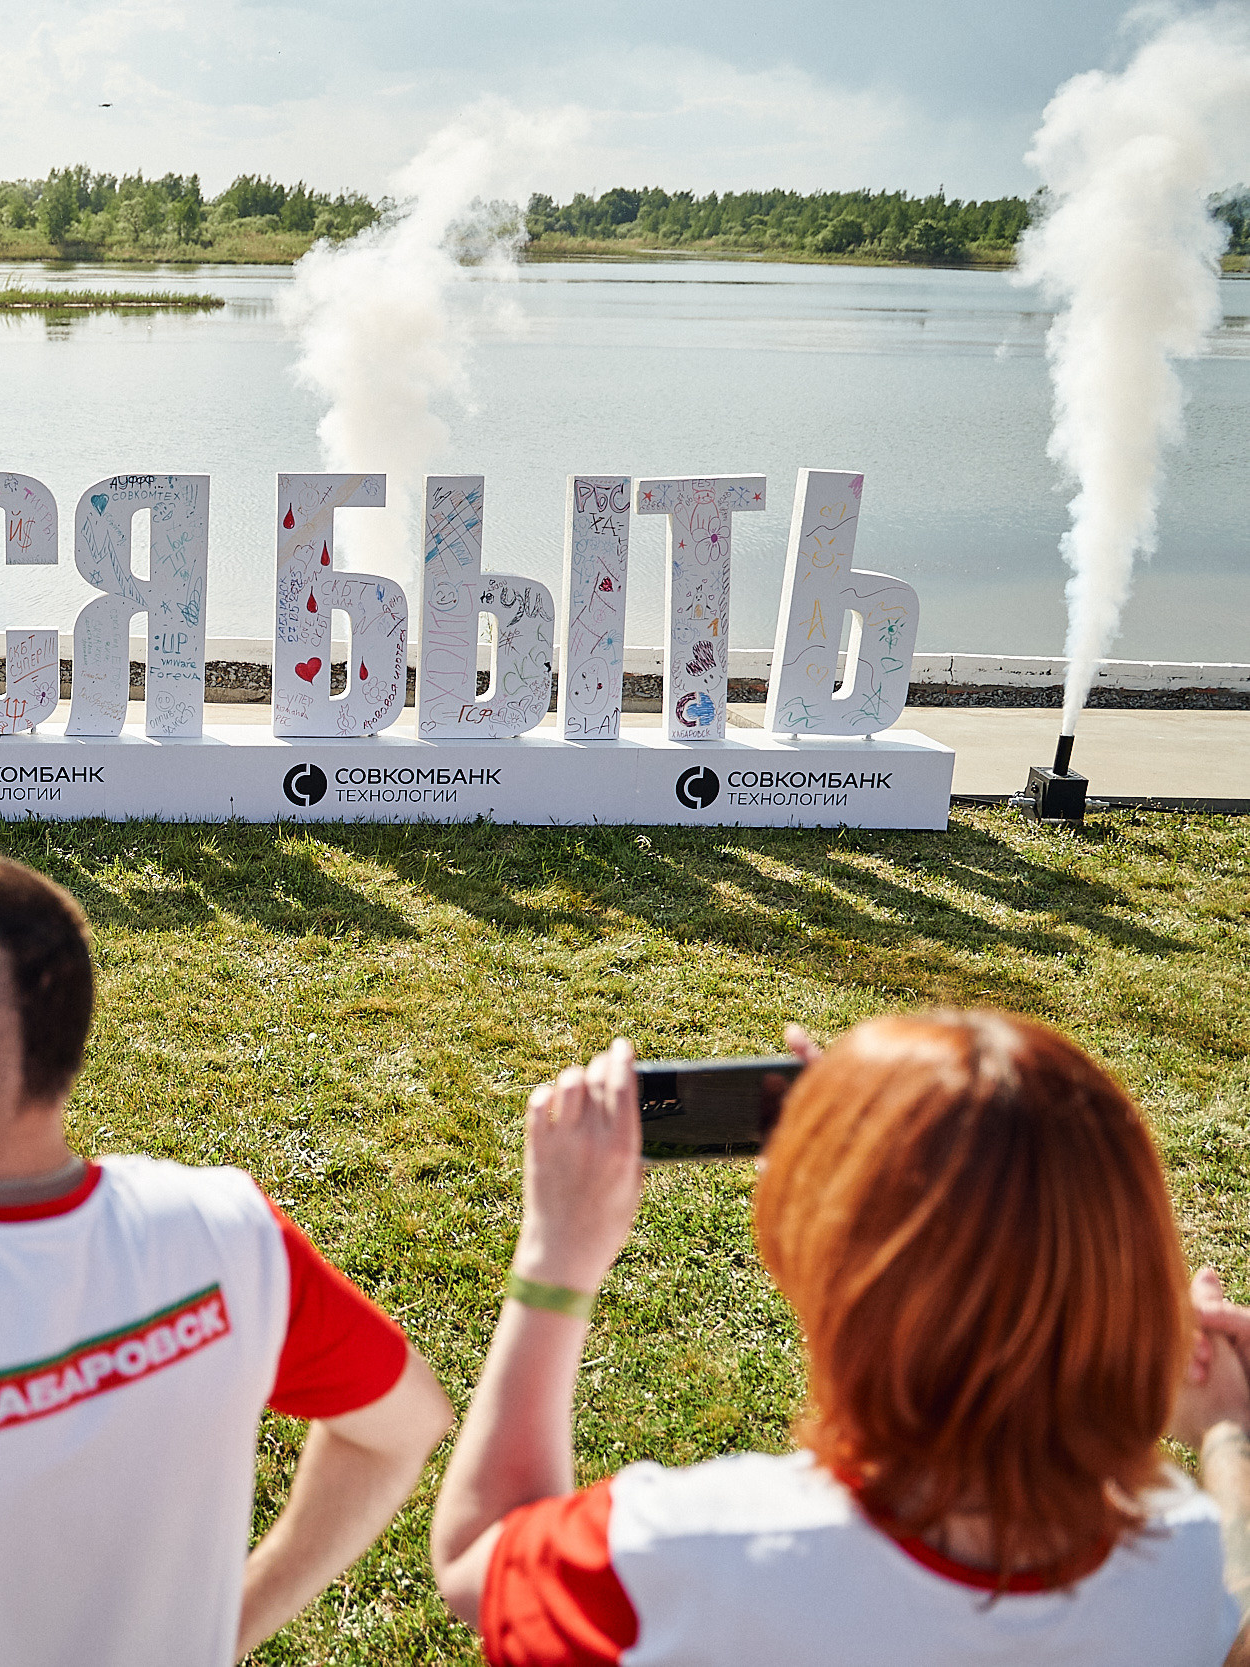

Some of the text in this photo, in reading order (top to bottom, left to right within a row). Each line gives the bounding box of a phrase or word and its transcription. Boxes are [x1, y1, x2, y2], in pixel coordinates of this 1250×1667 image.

[321, 579, 376, 600] СКБТ
[273, 467, 920, 740] БЫТЬ
[9, 634, 36, 662] СКБТ
[334, 767, 502, 785] СОВКОМБАНК
[727, 771, 893, 789] СОВКОМБАНК
[335, 789, 457, 803] ТЕХНОЛОГИИ
[726, 792, 848, 806] ТЕХНОЛОГИИ
